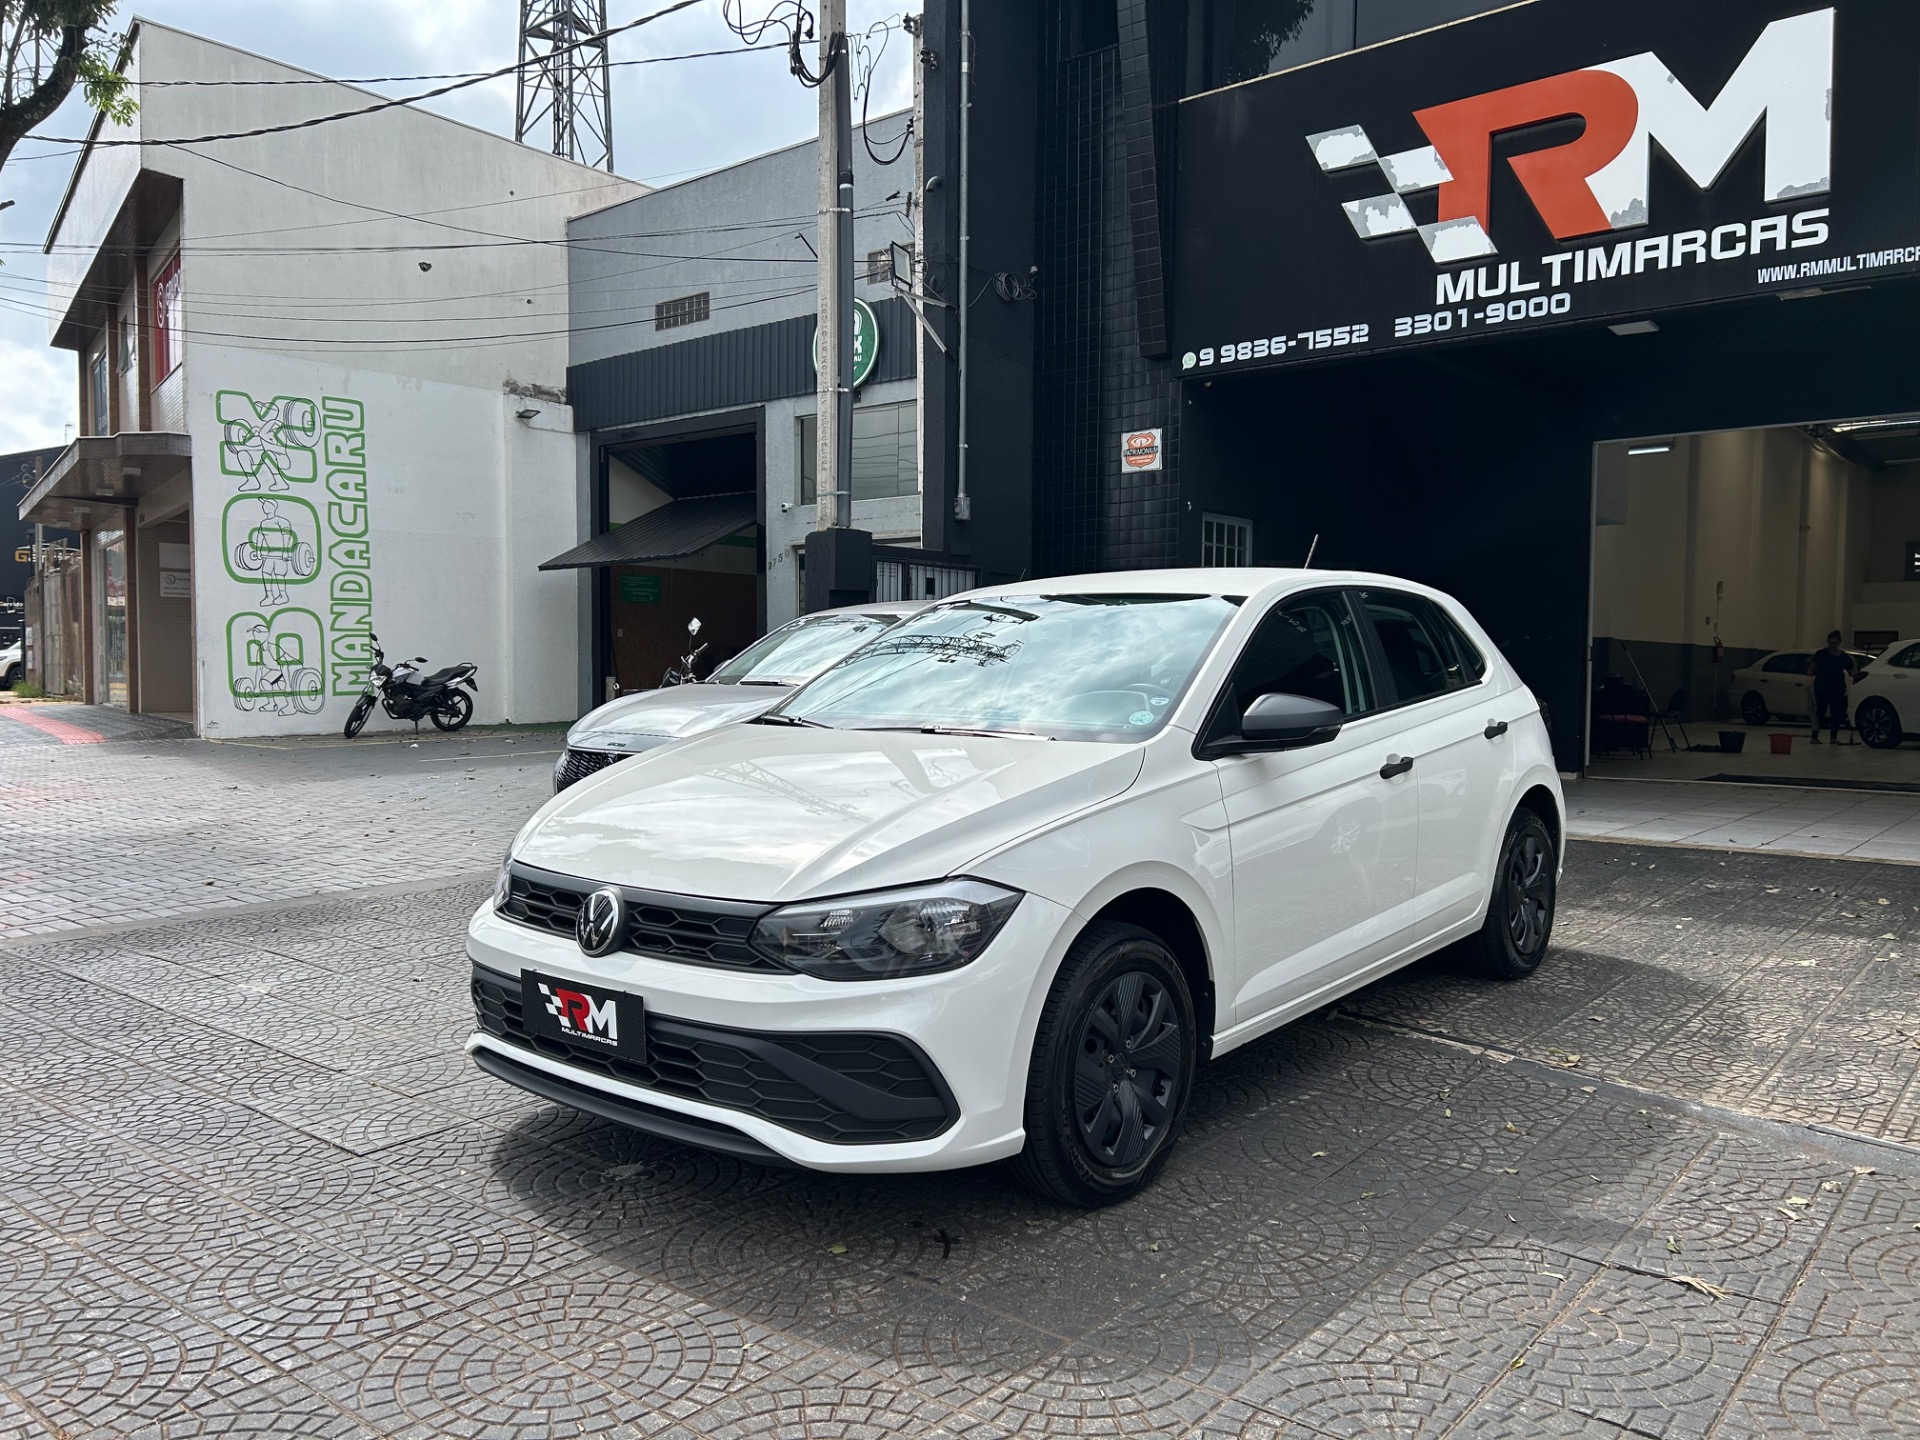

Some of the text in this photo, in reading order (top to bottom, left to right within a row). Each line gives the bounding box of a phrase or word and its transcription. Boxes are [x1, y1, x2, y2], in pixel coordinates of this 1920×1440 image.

[1412, 7, 1835, 239] RM
[1436, 208, 1829, 305] MULTIMARCAS
[1199, 292, 1571, 367] 9 9836-7552 3301-9000
[216, 389, 325, 698] BOX
[321, 396, 374, 697] MANDACARU
[555, 987, 618, 1040] RM
[561, 1026, 618, 1047] MULTIMARCAS
